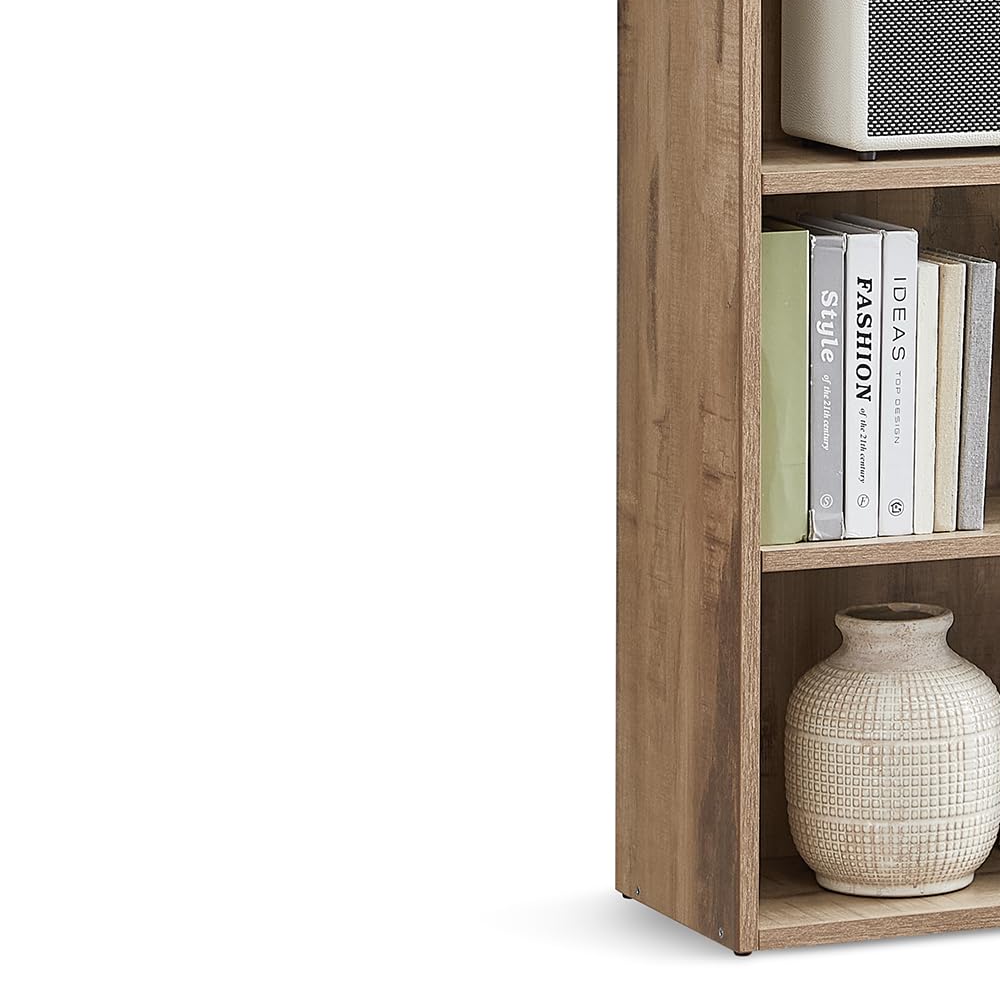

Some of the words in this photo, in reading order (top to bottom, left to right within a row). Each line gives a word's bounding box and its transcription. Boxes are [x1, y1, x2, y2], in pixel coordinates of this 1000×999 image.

[816, 290, 839, 363] Style
[892, 277, 907, 361] IDEAS
[856, 276, 873, 402] FASHION
[821, 374, 832, 385] of
[823, 386, 832, 400] the
[823, 400, 832, 418] 21th
[859, 408, 868, 418] of
[860, 419, 868, 433] the
[821, 420, 830, 451] century
[860, 434, 868, 452] 21th
[858, 453, 866, 484] century
